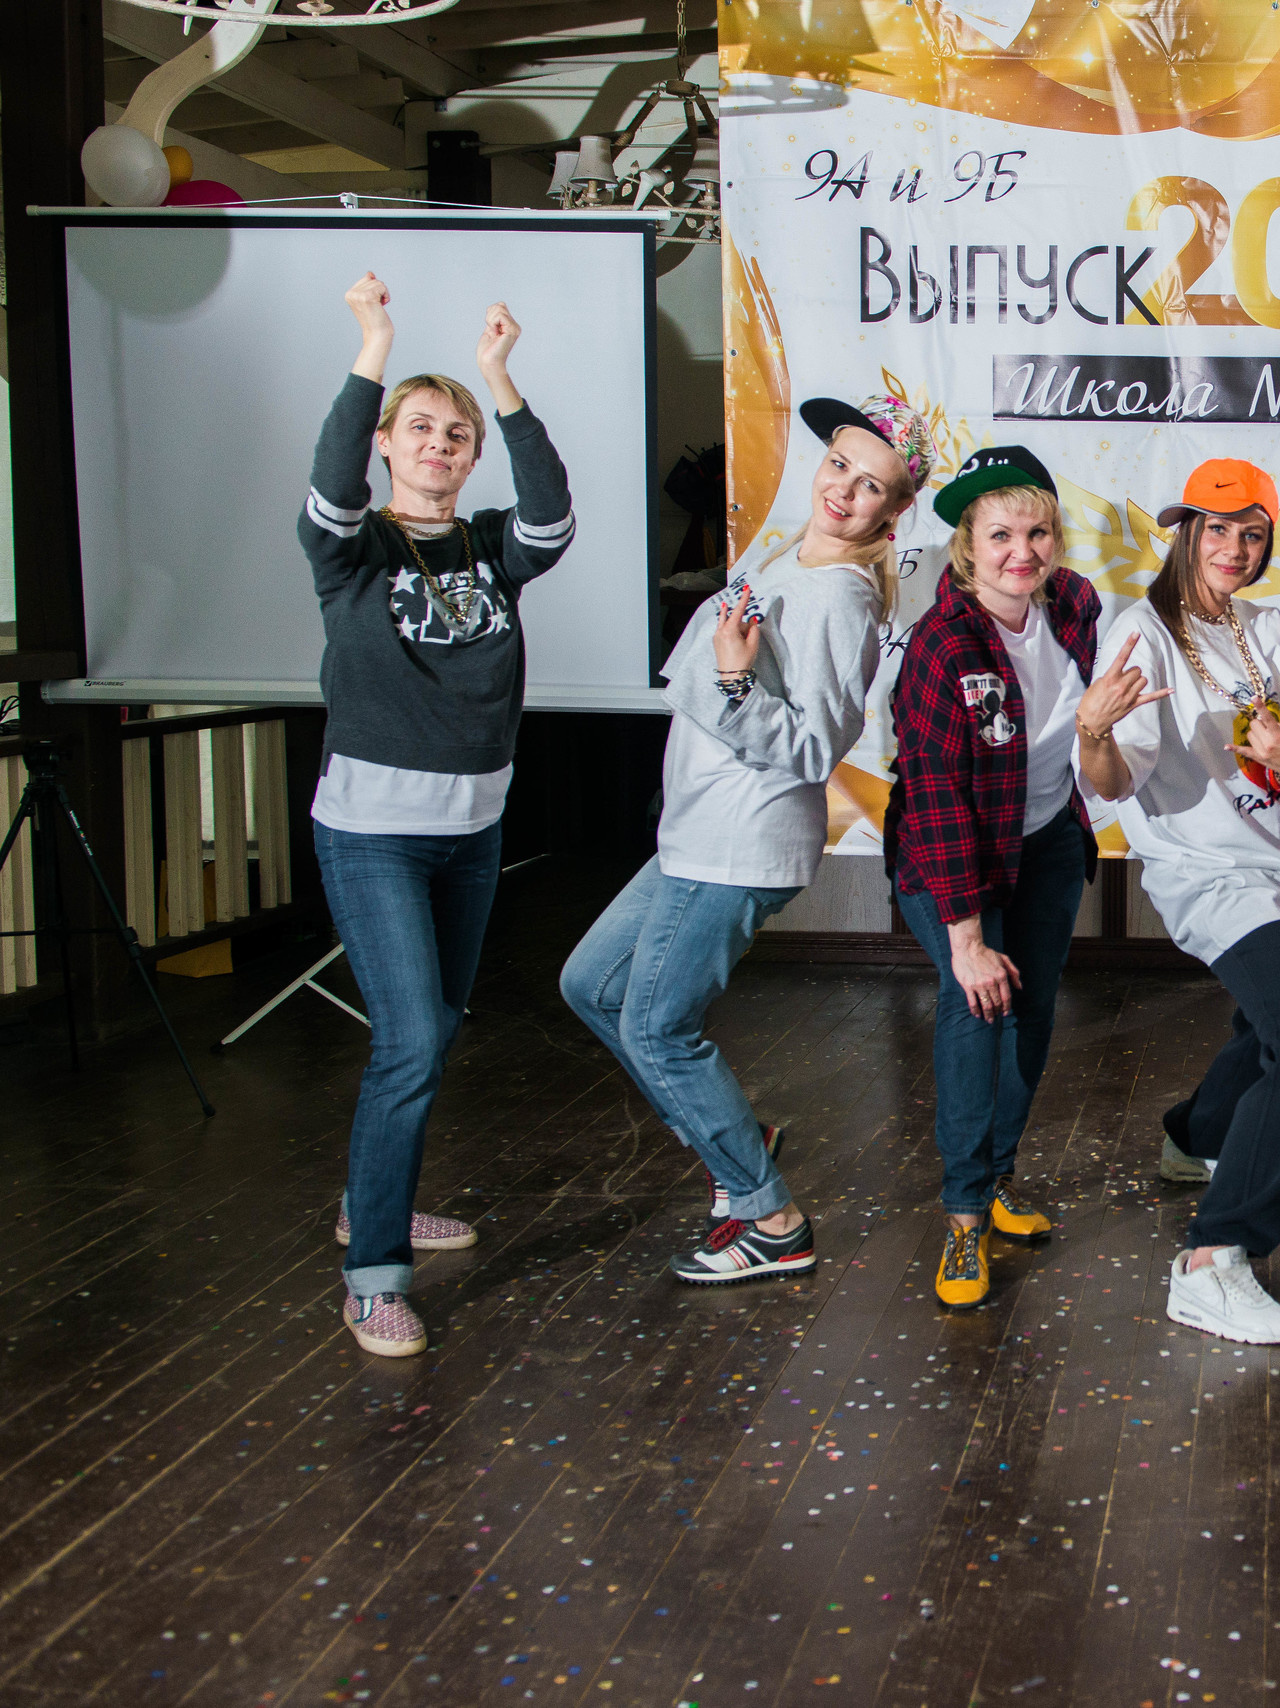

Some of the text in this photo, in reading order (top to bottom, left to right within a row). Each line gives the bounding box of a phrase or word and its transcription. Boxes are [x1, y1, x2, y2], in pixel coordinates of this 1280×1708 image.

[795, 149, 1028, 204] 9А и 9Б
[1005, 362, 1219, 421] Школа
